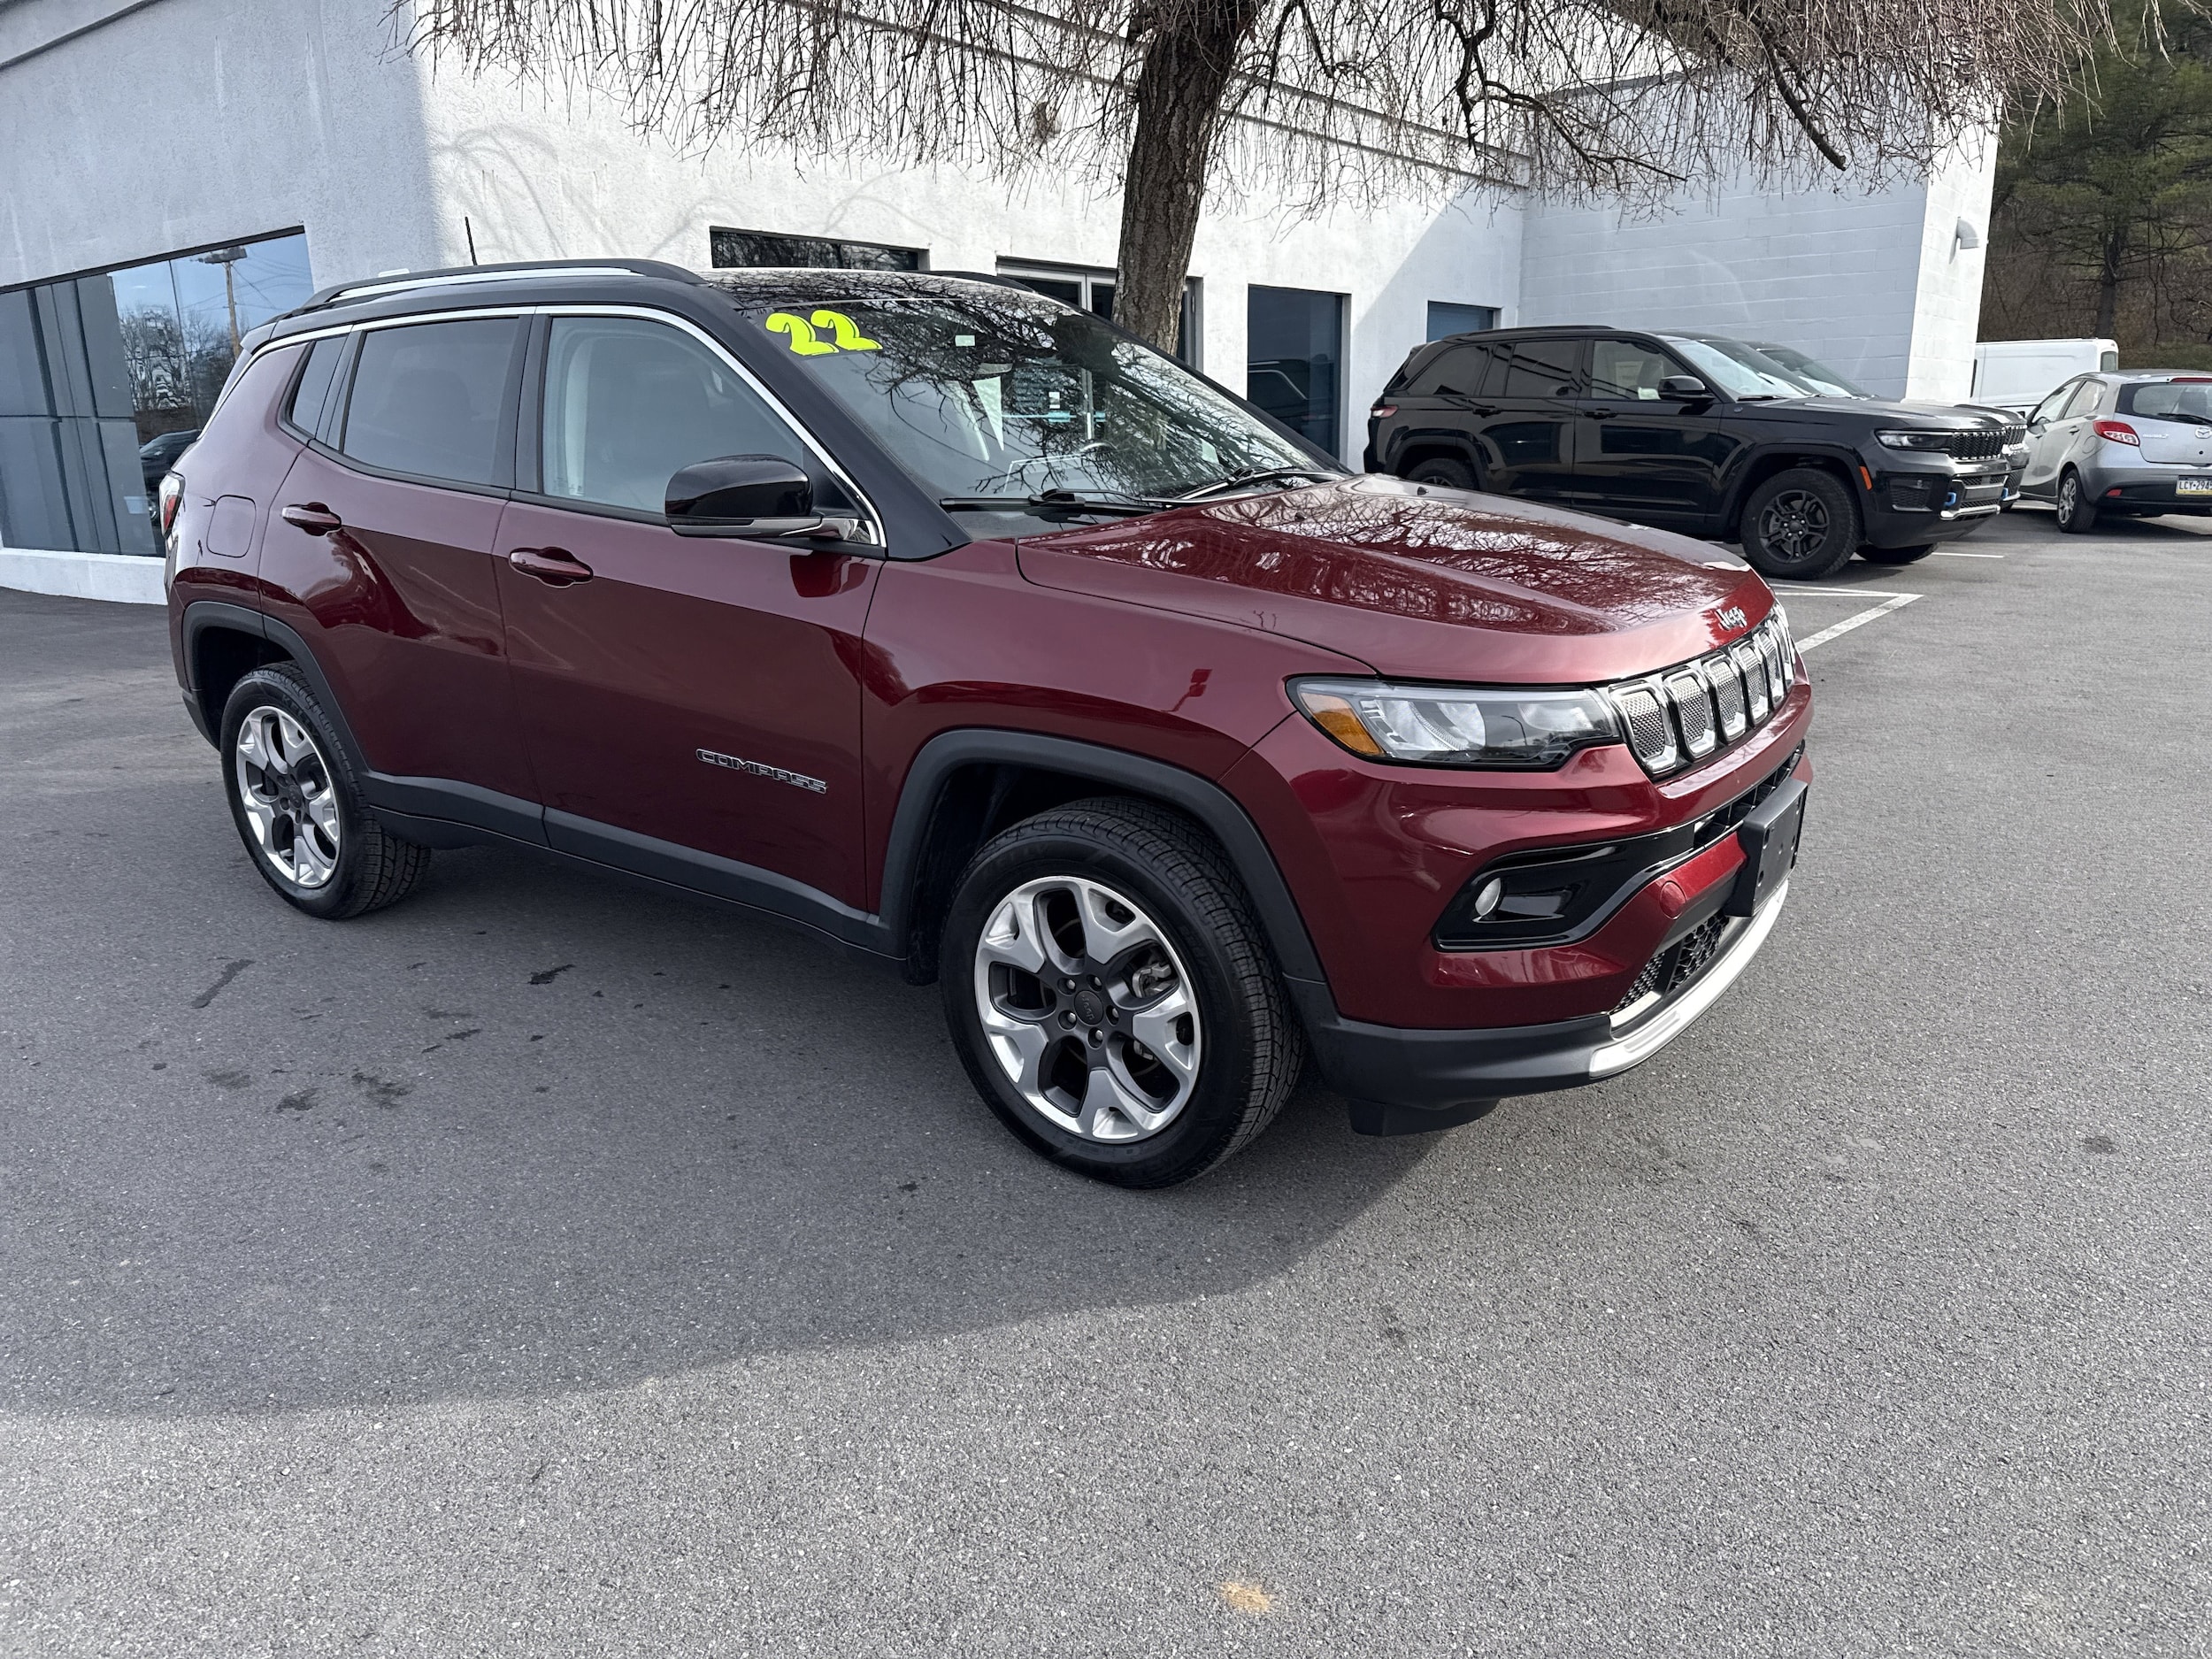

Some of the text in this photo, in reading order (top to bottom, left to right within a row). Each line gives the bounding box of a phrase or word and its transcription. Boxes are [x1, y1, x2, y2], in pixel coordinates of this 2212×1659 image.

[764, 309, 884, 356] 22
[1716, 606, 1747, 630] Jeep
[695, 748, 828, 795] COMPASS
